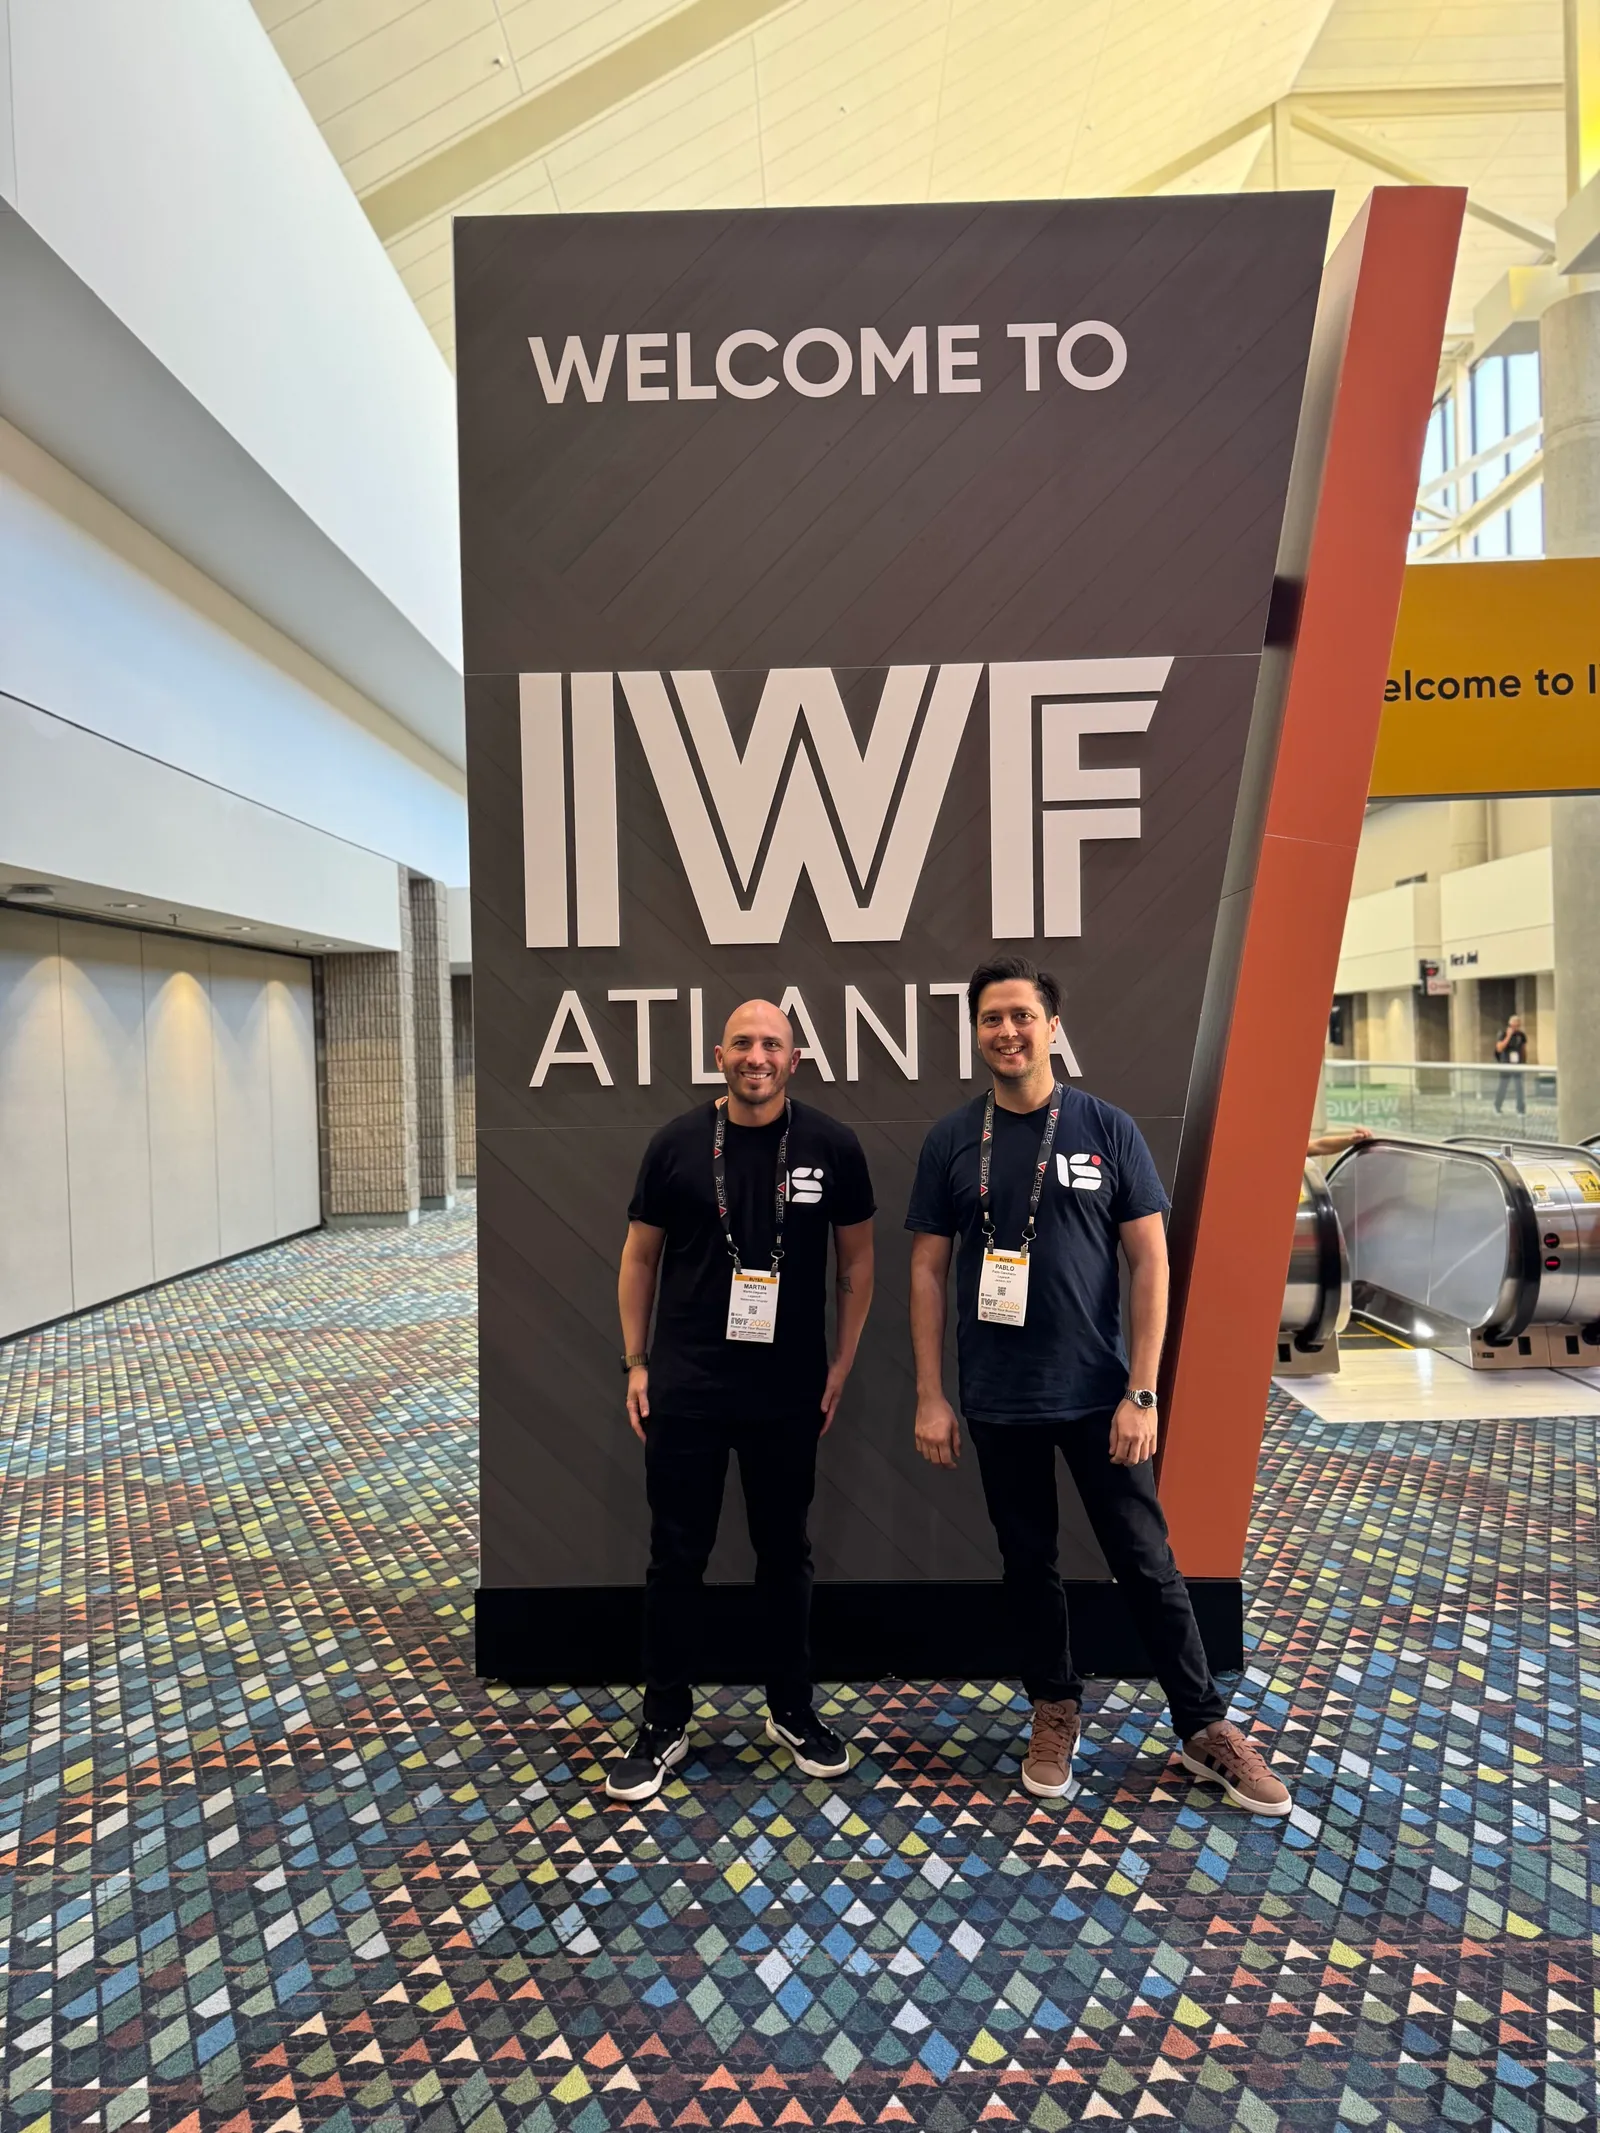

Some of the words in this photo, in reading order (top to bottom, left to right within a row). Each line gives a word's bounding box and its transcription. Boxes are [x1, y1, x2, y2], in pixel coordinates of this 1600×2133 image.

[527, 325, 981, 404] WELCOME
[1007, 320, 1128, 392] TO
[1384, 669, 1522, 702] elcome
[1534, 669, 1574, 696] to
[519, 656, 1174, 948] IWF
[744, 1283, 767, 1291] MARTIN
[981, 1298, 998, 1306] IWF
[999, 1300, 1020, 1310] 2026
[731, 1317, 749, 1325] IWF
[750, 1319, 771, 1328] 2026
